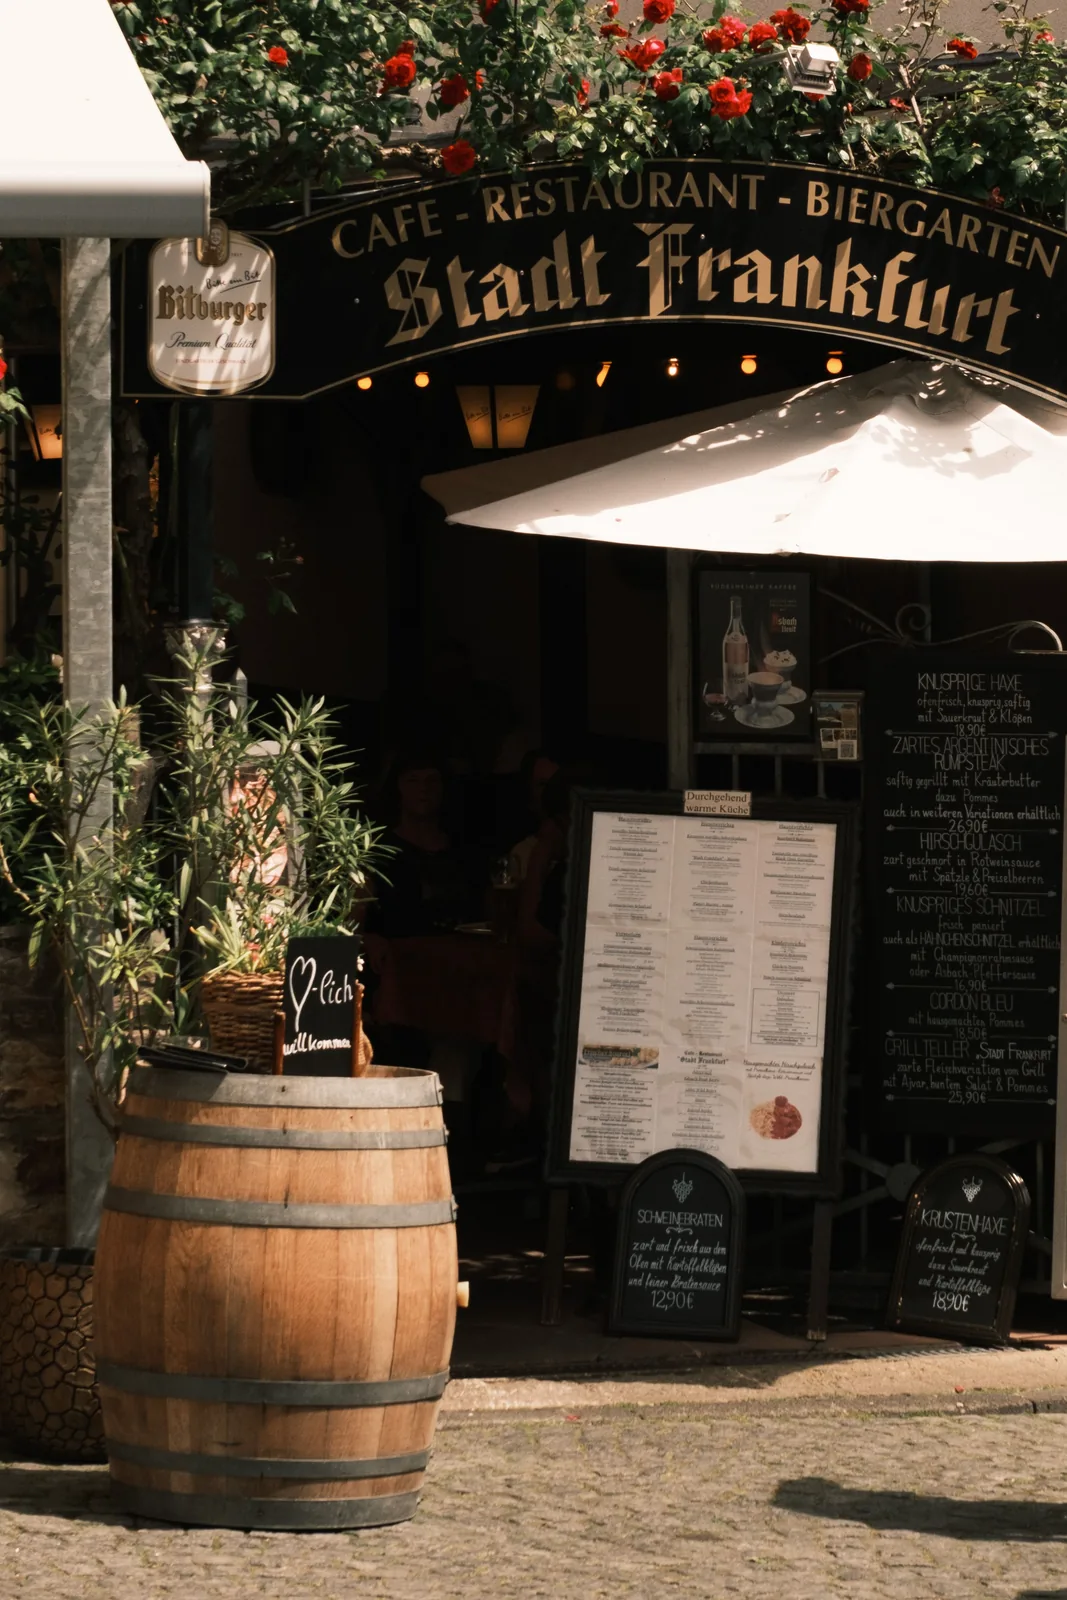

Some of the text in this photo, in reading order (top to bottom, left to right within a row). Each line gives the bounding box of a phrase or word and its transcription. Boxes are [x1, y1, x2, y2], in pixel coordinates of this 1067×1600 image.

[331, 199, 443, 259] CAFE
[482, 171, 766, 224] RESTAURANT
[806, 180, 1061, 279] BIERGARTEN
[384, 222, 1021, 356] Stadt Frankfurt
[155, 285, 268, 326] Bitburger
[165, 331, 257, 350] Premium Qualität
[918, 672, 1023, 692] KNUSPRIGE HAXE
[917, 708, 1032, 727] mit Sauerkraut & Klößen
[954, 724, 986, 738] 18,90€
[892, 736, 1050, 756] ZARTES ARGENTINISCHES
[934, 754, 1006, 772] RUMPSTEAK
[886, 771, 1041, 789] saftig gegrillt mit Kräuterbutter
[686, 792, 747, 803] Durchgehend
[935, 788, 998, 802] dazu Pommes
[686, 804, 748, 815] warme Küche
[884, 803, 1061, 820] auch in weiteren Variationen erhältlich
[920, 832, 1022, 852] HIRSCHGULASCH
[884, 852, 904, 865] zart
[906, 851, 952, 869] geschmort
[957, 854, 966, 866] in
[909, 866, 1044, 886] mit Spätzle & Preiselbeeren
[896, 896, 1046, 917] KNUSPRIGES SCHNITZEL
[938, 914, 1006, 932] frisch paniert
[882, 930, 903, 945] auch
[905, 932, 918, 945] als
[910, 950, 926, 962] mit
[909, 964, 930, 978] oder
[954, 980, 988, 994] 16,90€
[929, 992, 1014, 1012] CORDON BLEU
[908, 1012, 924, 1026] mit
[989, 1012, 1025, 1028] Pommes
[282, 1032, 352, 1056] willkommen
[924, 1058, 1001, 1076] Fleischvariation
[1021, 1061, 1046, 1078] Grill
[882, 1072, 897, 1088] mit
[930, 1074, 962, 1090] buntem
[965, 1075, 992, 1092] Salat
[996, 1077, 1004, 1092] &
[1007, 1077, 1049, 1094] Pommes
[948, 1091, 986, 1106] 25,90€
[637, 1209, 723, 1228] SCHWEINEBRATEN
[920, 1208, 1008, 1236] KRUSTENHAXE
[632, 1237, 655, 1250] zart
[656, 1238, 672, 1251] und
[673, 1238, 699, 1254] frisch
[700, 1246, 712, 1254] aus
[916, 1238, 954, 1254] ofenfrisch
[955, 1242, 970, 1255] und
[629, 1254, 650, 1270] Ofen
[650, 1256, 664, 1270] mit
[928, 1256, 990, 1276] dazu Sauerkraut
[628, 1272, 644, 1286] und
[645, 1272, 668, 1290] feiner
[918, 1273, 935, 1287] und
[651, 1290, 695, 1312] 12,90€
[932, 1290, 971, 1312] 18,90€
